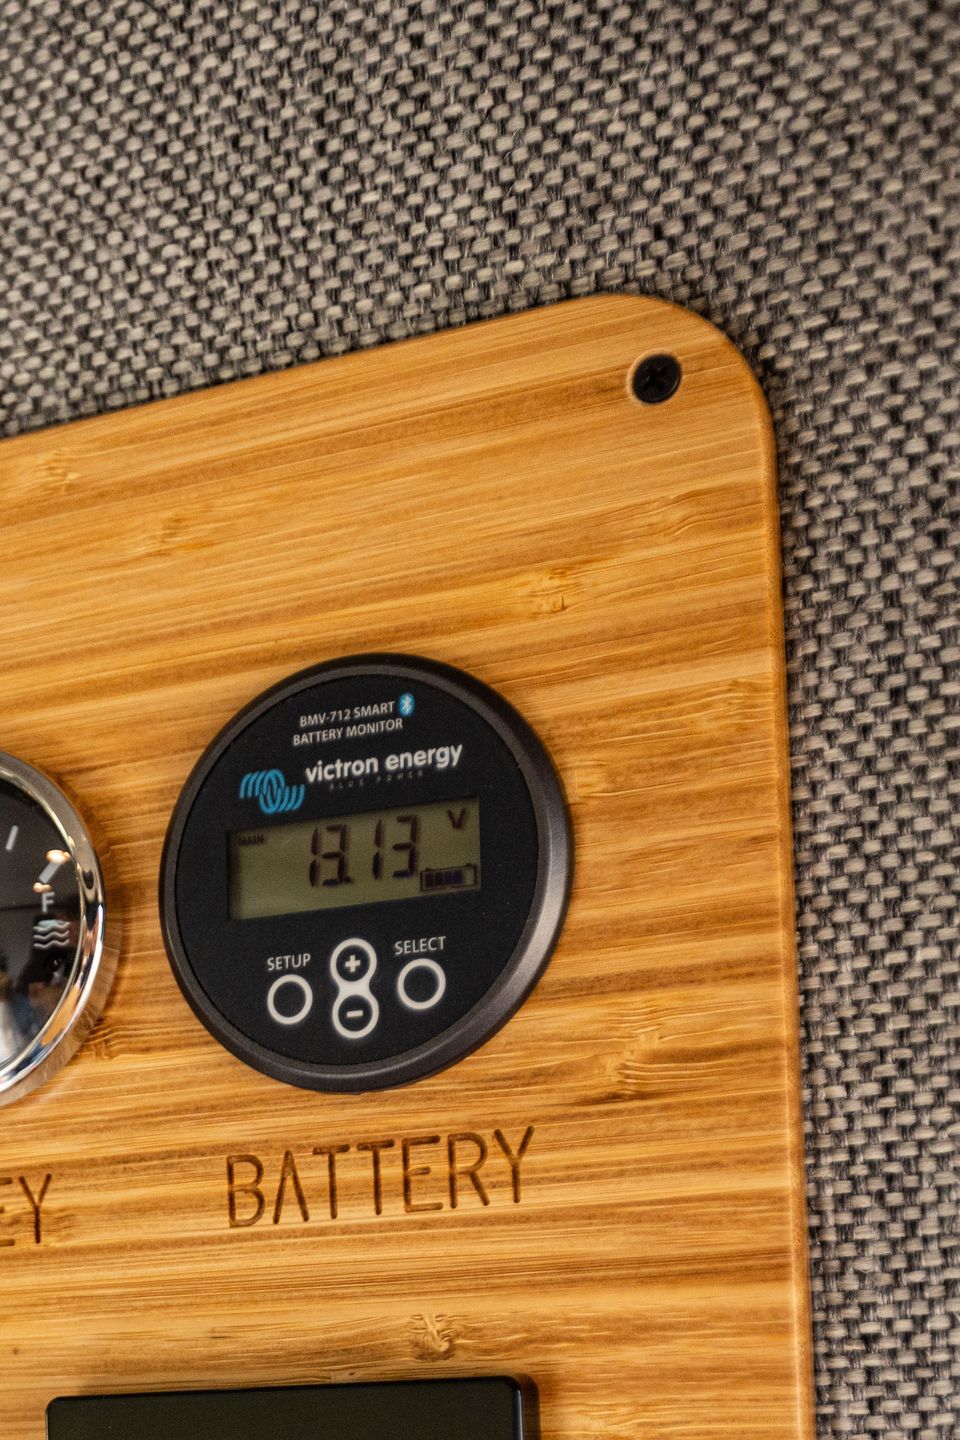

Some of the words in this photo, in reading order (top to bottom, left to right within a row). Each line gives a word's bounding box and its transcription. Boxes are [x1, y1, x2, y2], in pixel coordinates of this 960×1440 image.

[300, 708, 351, 728] BMV-712
[353, 701, 395, 719] SMART
[293, 728, 343, 746] BATTERY
[346, 718, 403, 738] MONITOR
[305, 757, 379, 784] victron
[385, 744, 463, 770] energy
[446, 806, 467, 830] V
[41, 890, 55, 913] F
[394, 936, 447, 956] SELECT
[267, 952, 312, 972] SETUP
[226, 1125, 535, 1229] BATTERY
